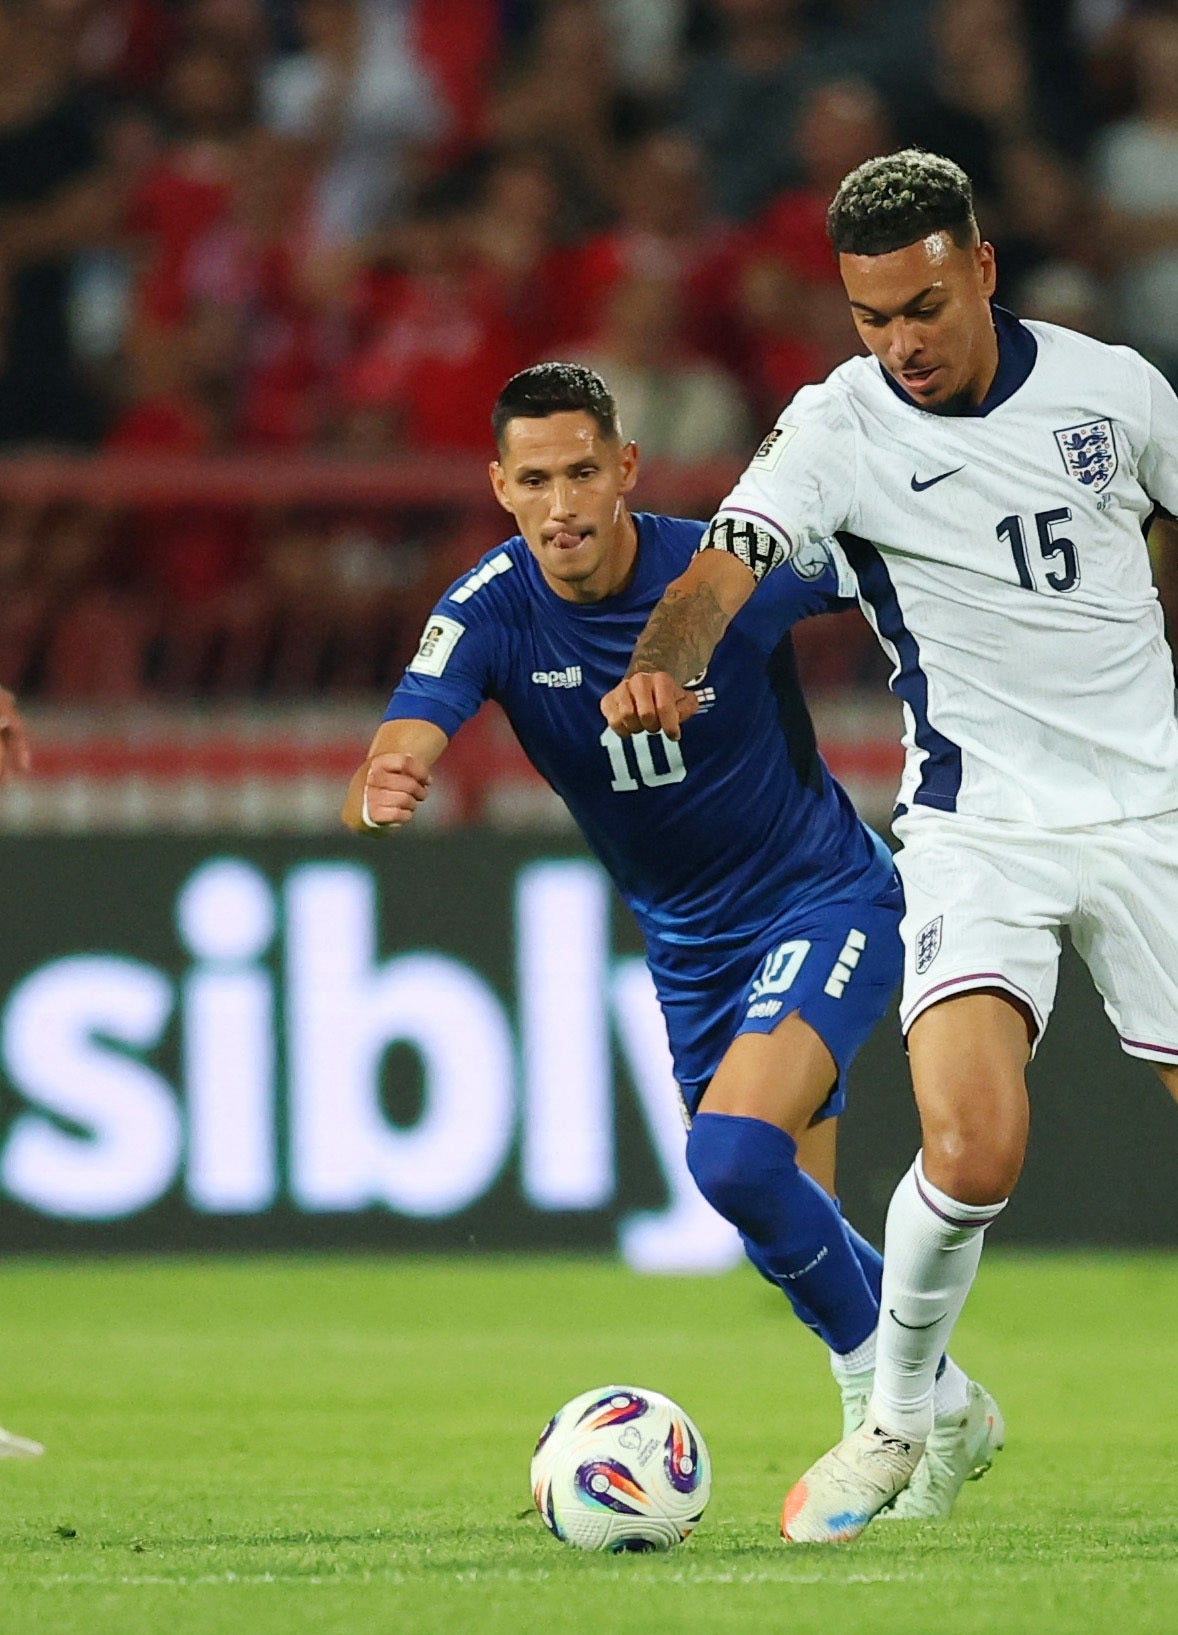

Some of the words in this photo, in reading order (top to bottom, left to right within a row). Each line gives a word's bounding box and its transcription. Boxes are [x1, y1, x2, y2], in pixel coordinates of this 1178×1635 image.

[996, 507, 1081, 593] 15
[532, 665, 582, 688] capelli
[600, 726, 687, 792] 10
